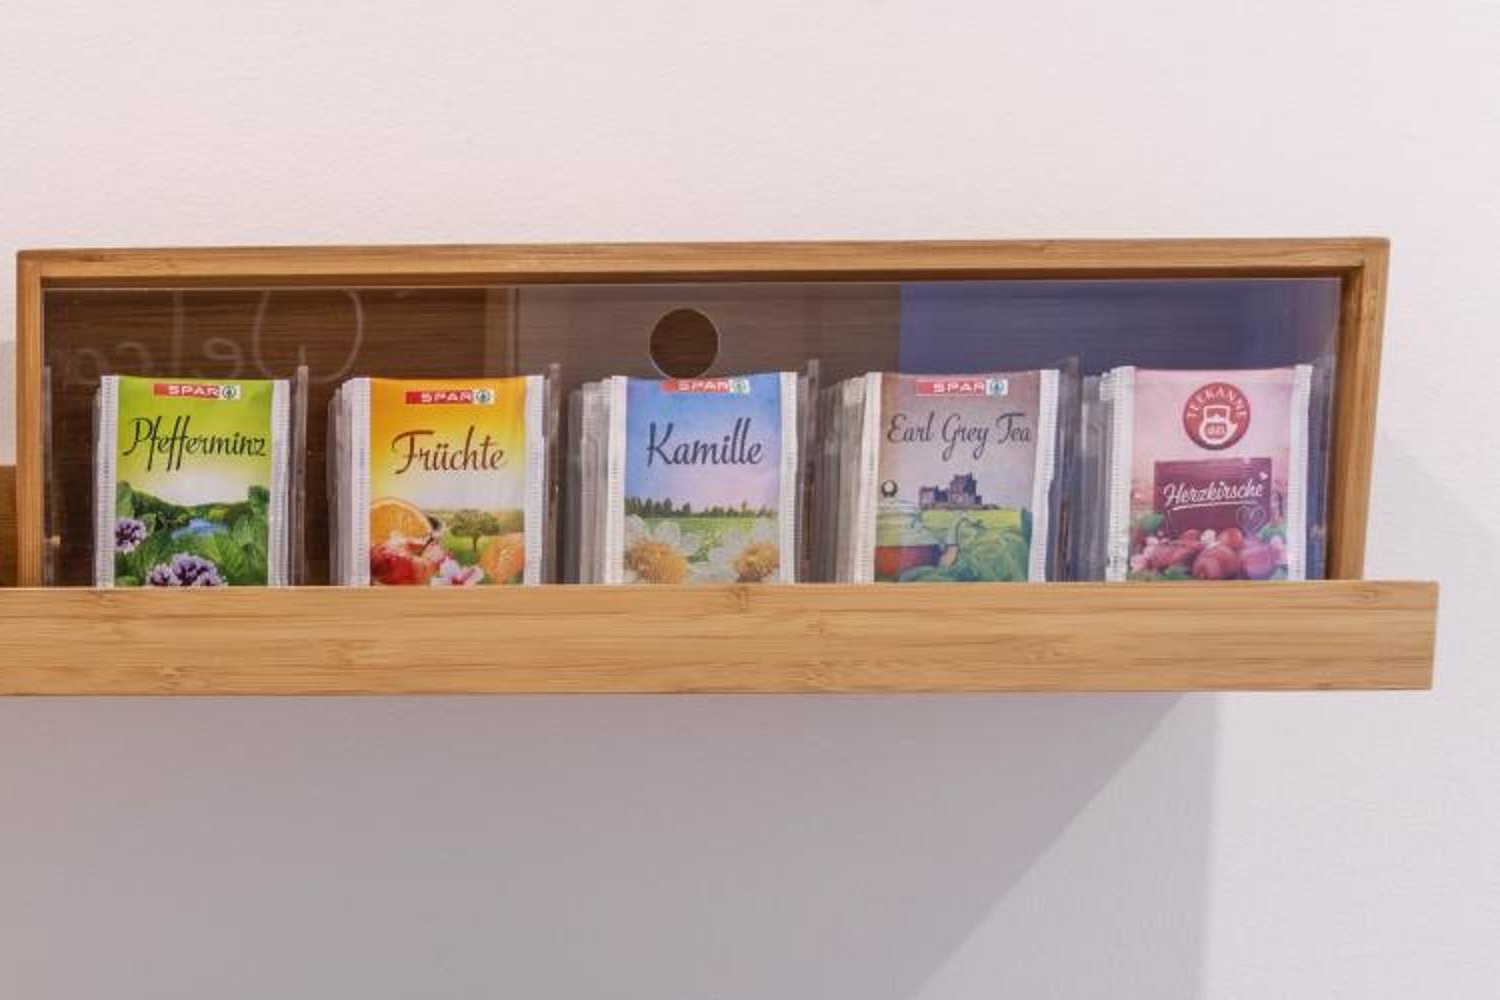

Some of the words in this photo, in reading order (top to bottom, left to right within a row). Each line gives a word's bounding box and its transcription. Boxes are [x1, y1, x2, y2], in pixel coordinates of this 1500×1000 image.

[166, 384, 220, 397] SPAR
[420, 391, 472, 403] SPAR
[677, 380, 731, 393] SPAR
[931, 382, 986, 394] SPAR
[122, 415, 267, 472] Pfefferminz
[391, 424, 506, 475] Früchte
[646, 417, 763, 467] Kamille
[887, 411, 934, 445] Earl
[941, 412, 991, 462] Grey
[995, 411, 1032, 445] Tea
[1163, 478, 1264, 506] Herzkirsche
